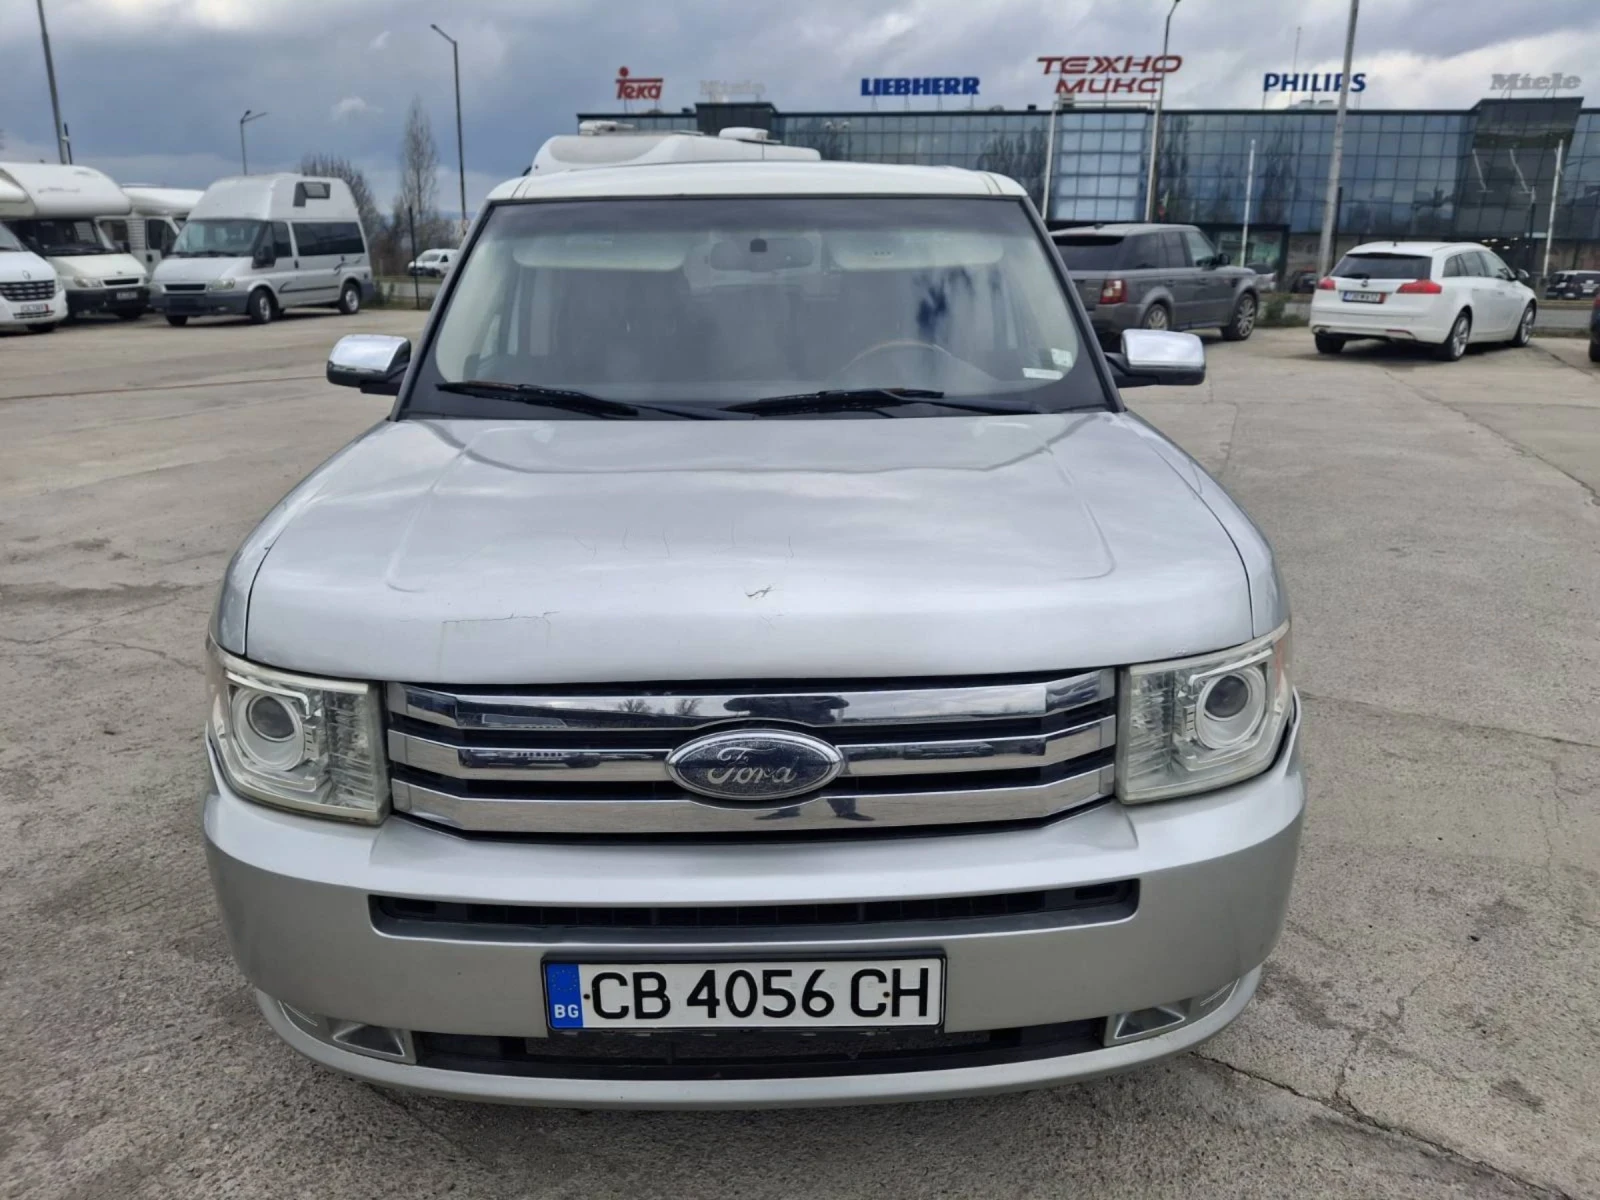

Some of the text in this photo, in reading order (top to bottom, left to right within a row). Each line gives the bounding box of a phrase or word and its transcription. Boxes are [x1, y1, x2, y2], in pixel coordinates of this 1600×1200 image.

[861, 77, 981, 96] LIEBHERR
[1490, 73, 1582, 91] Miele
[707, 747, 799, 785] Ford
[591, 967, 930, 1020] CB 4056 CH
[554, 1004, 580, 1019] BG
